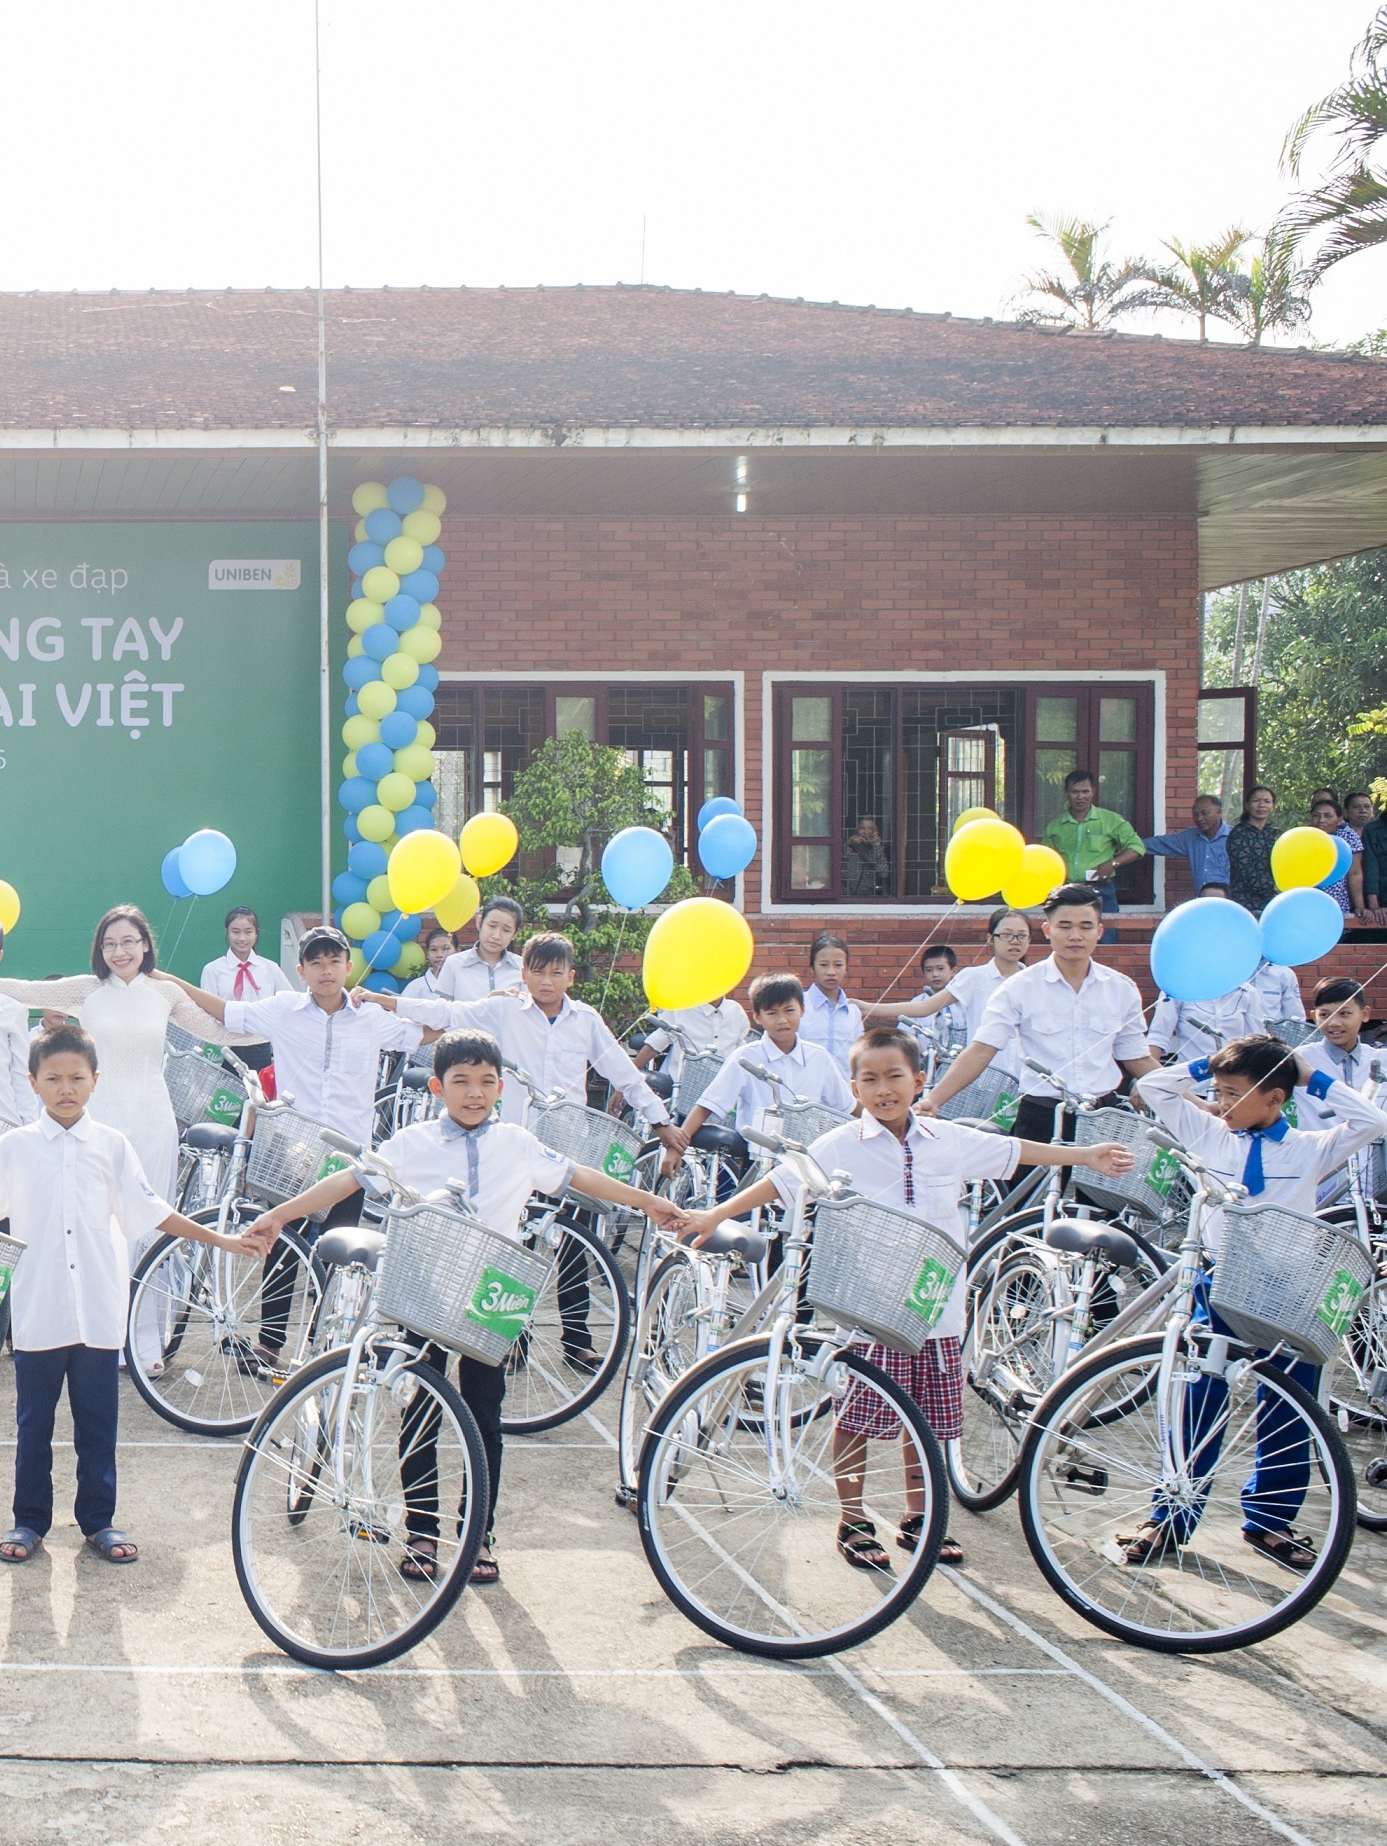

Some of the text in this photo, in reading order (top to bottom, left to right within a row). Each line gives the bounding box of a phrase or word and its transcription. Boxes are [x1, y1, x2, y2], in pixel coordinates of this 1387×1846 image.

[22, 568, 58, 589] xe
[69, 562, 129, 596] đạp
[214, 568, 272, 581] UNIBEN
[80, 616, 184, 662] TAY
[55, 669, 186, 740] VIỆT
